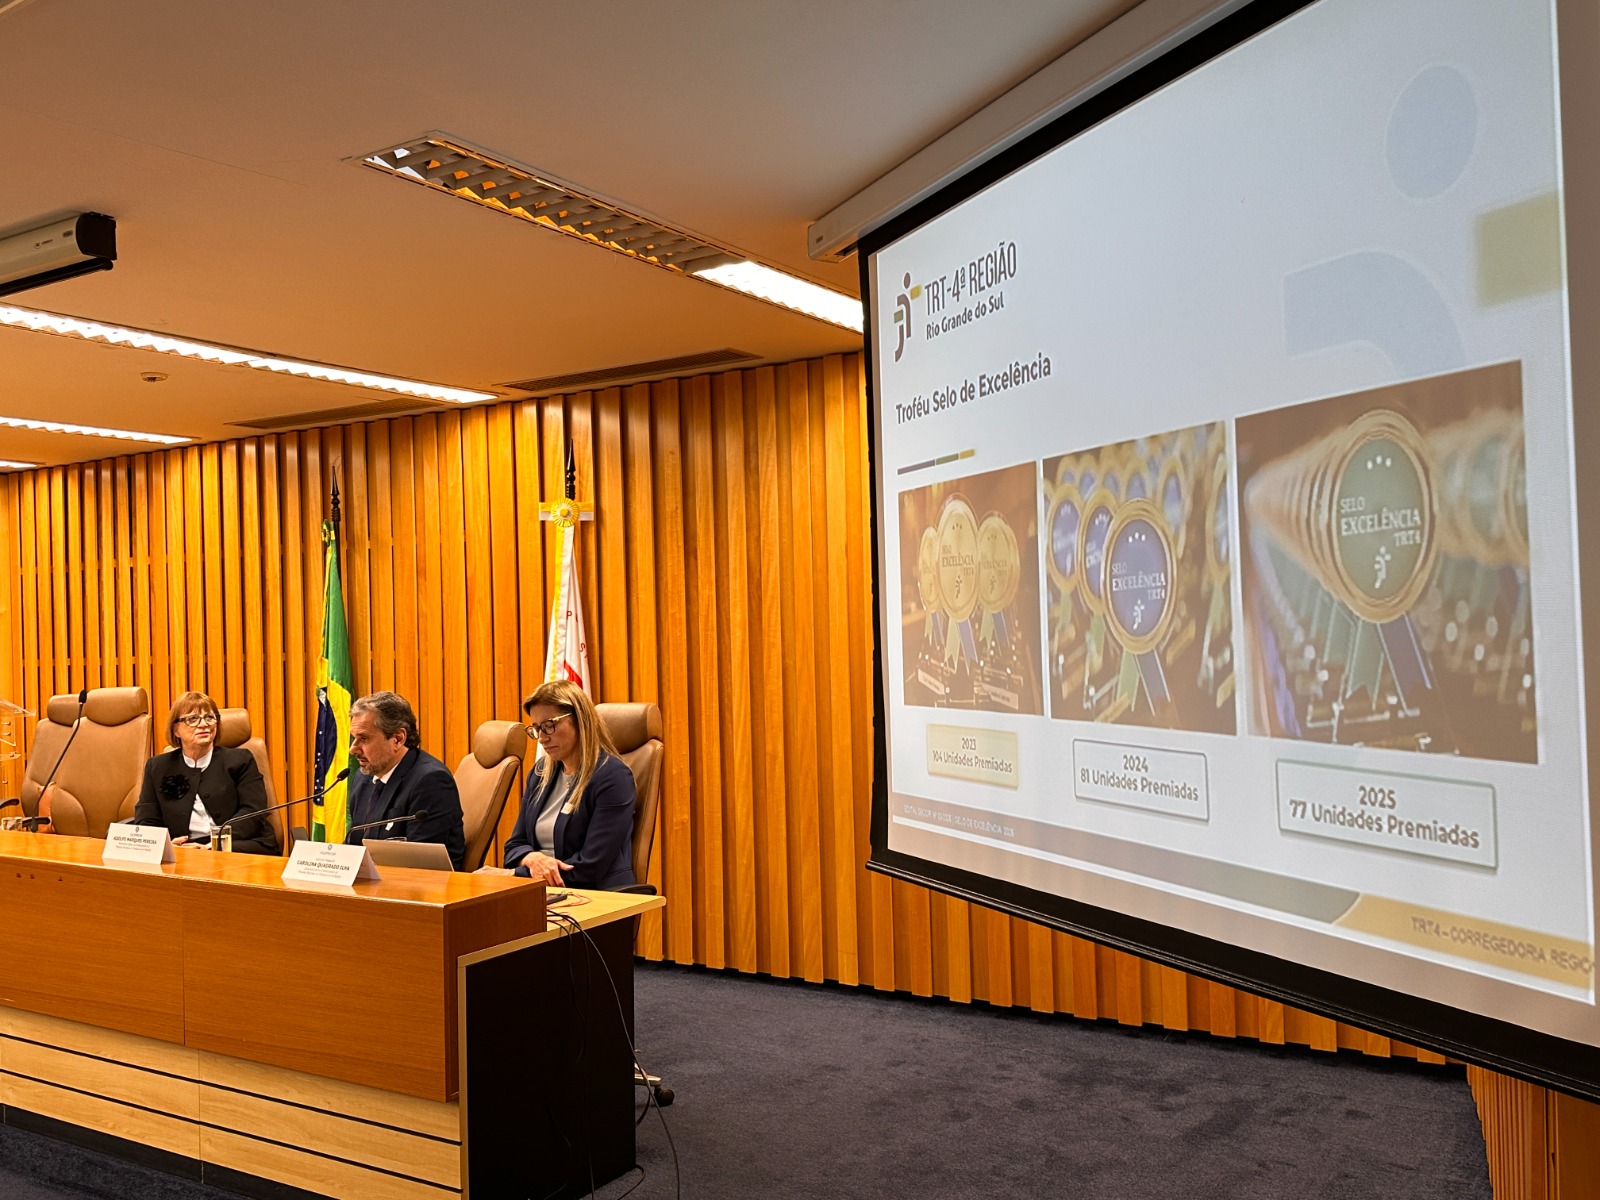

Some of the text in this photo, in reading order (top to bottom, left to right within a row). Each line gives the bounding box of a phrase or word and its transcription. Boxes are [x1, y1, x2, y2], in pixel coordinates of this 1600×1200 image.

[924, 240, 1017, 316] TRT-4ª REGIÃO
[926, 291, 1005, 340] Rio Grande do Sul
[895, 352, 1051, 424] Troféu Selo de Excelência
[1340, 497, 1365, 514] SELO
[1341, 507, 1422, 536] EXCELÊNCIA
[1112, 571, 1166, 592] EXCELÊNCIA
[961, 737, 977, 751] 2023
[932, 750, 1013, 774] 104 Unidades Premiadas
[1123, 754, 1149, 773] 2024
[1080, 767, 1199, 802] 81 Unidades Premiadas
[1358, 785, 1397, 810] 2025
[1289, 799, 1480, 849] 77 Unidades Premiadas
